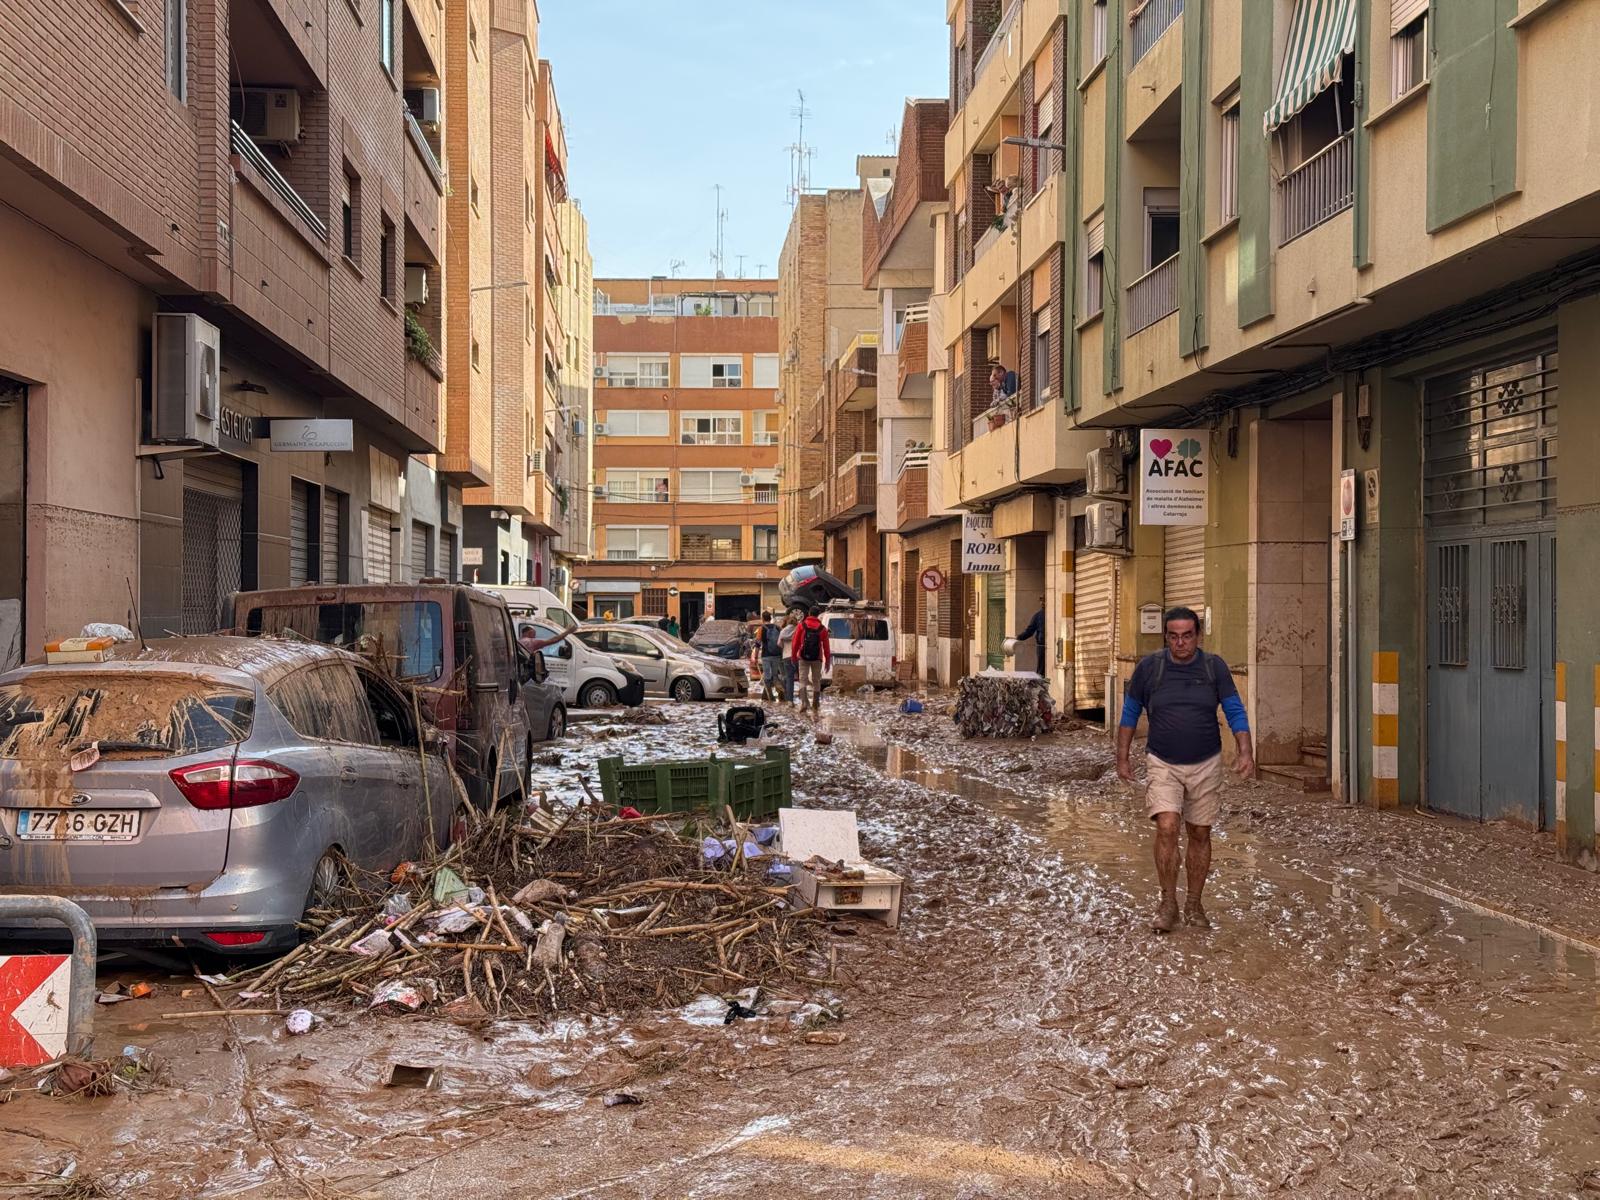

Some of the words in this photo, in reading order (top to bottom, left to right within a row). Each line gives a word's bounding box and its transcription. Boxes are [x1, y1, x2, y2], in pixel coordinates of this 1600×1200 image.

[1148, 459, 1203, 477] AFAC
[966, 542, 1002, 555] ROPA
[967, 561, 1001, 571] Inma
[31, 812, 85, 833] 776
[93, 813, 134, 834] GZH
